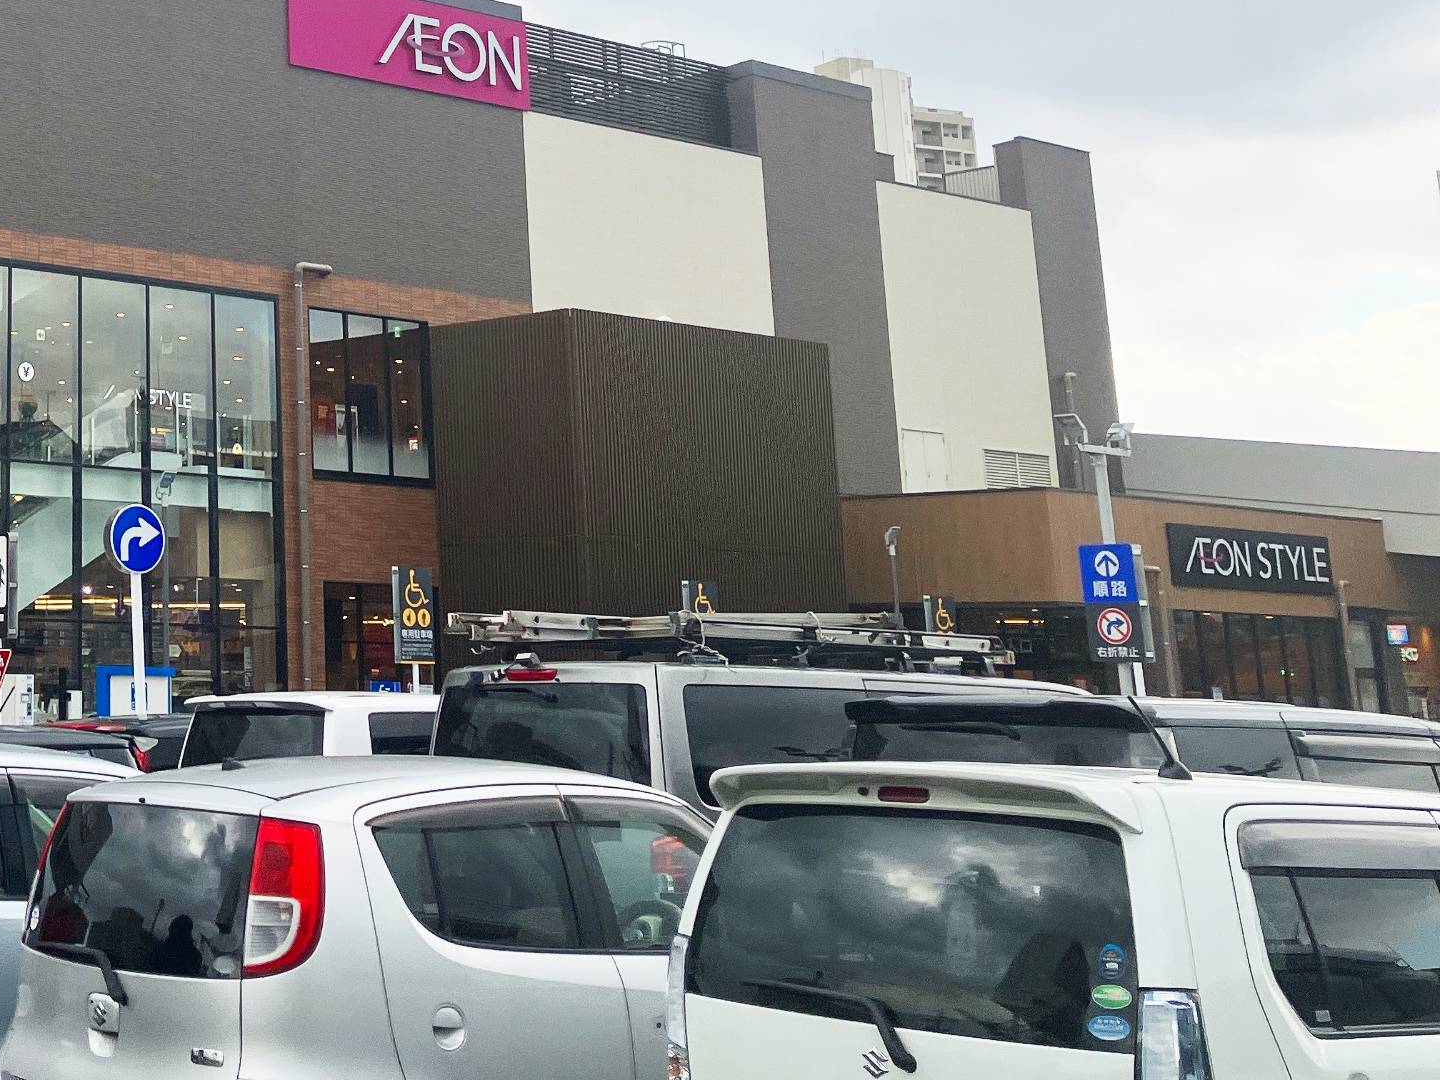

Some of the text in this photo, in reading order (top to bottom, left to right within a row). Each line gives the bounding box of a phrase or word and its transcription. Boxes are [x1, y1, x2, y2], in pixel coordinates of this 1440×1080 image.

[1257, 542, 1330, 583] STYLE
[1092, 580, 1127, 598] 順路
[1097, 646, 1140, 658] 右折禁止
